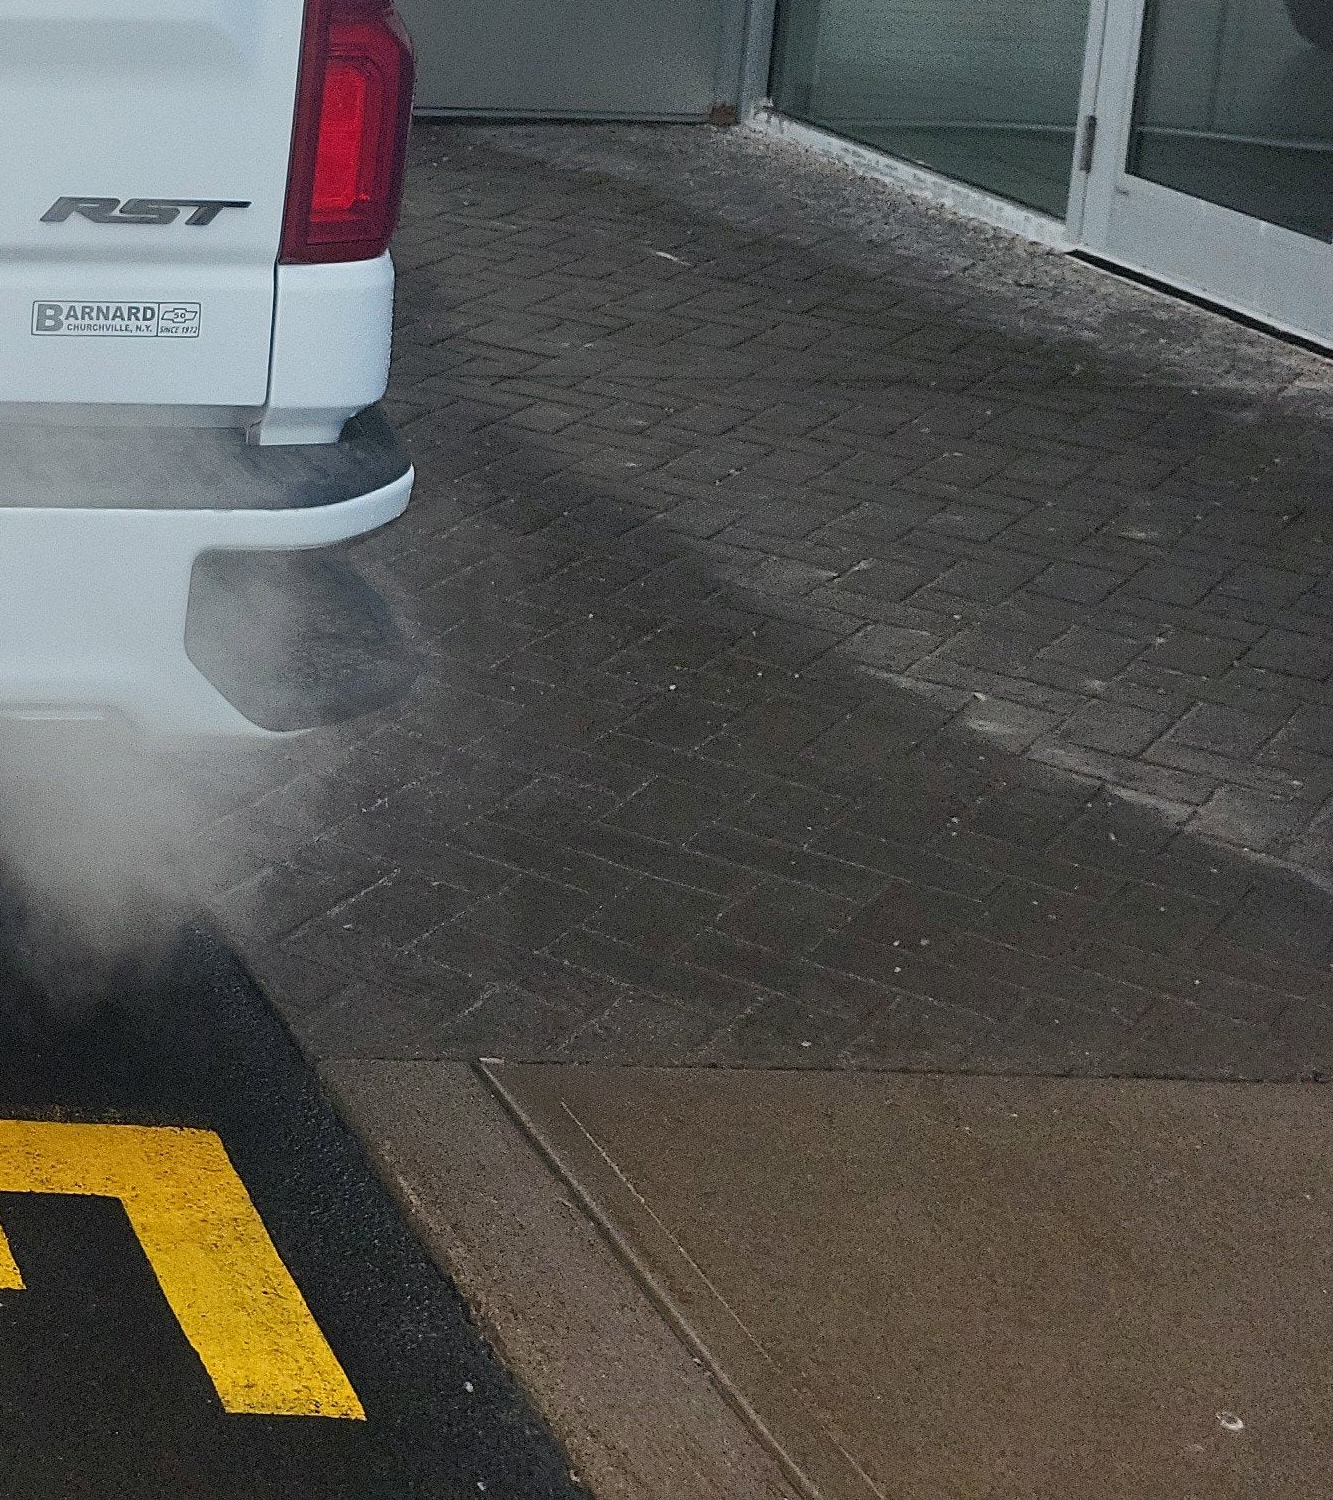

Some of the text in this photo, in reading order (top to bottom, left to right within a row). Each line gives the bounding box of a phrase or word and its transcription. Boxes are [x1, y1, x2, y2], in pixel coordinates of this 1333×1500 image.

[39, 196, 252, 226] RST
[36, 303, 156, 332] BARNARD
[135, 324, 153, 333] N.Y.
